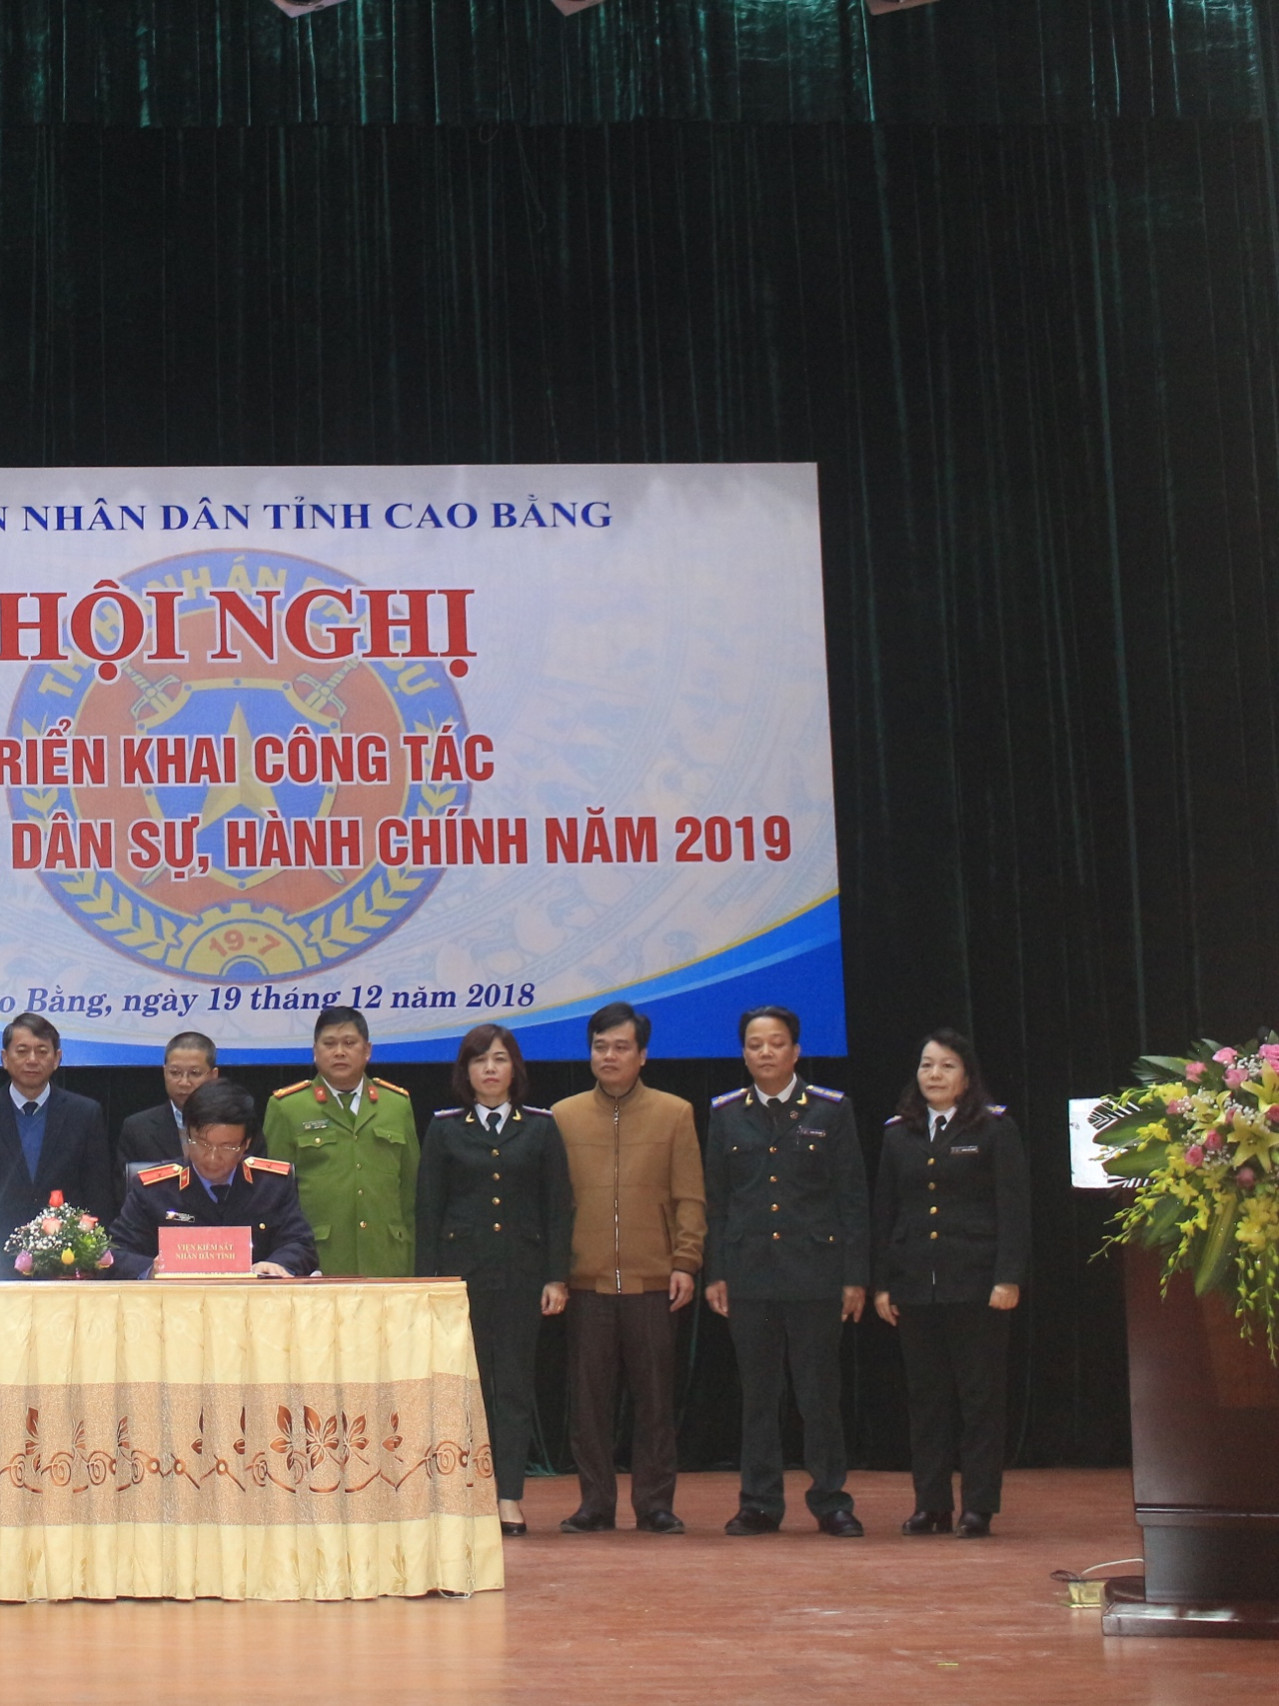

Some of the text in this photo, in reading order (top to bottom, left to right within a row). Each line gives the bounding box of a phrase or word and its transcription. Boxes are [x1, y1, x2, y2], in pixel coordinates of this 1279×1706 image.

[22, 497, 146, 531] NHÂN
[161, 496, 250, 530] DÂN
[263, 495, 370, 530] TỈNH
[384, 502, 478, 529] CAO
[490, 494, 612, 529] BẰNG
[210, 588, 477, 678] NGHỊ
[123, 735, 236, 785] KHAI
[254, 725, 387, 784] CÔNG
[403, 725, 494, 782] TÁC
[11, 811, 112, 869] DÂN
[130, 816, 210, 880] SỰ,
[227, 811, 361, 867] HÀNH
[379, 808, 528, 866] CHÍNH
[546, 807, 658, 864] NĂM
[675, 815, 791, 862] 2019
[24, 985, 112, 1018] Bằng,
[122, 989, 198, 1017] ngày
[207, 986, 241, 1011] 19
[250, 985, 341, 1011] tháng
[350, 984, 383, 1010] 12
[390, 986, 457, 1009] năm
[465, 982, 535, 1008] 2018
